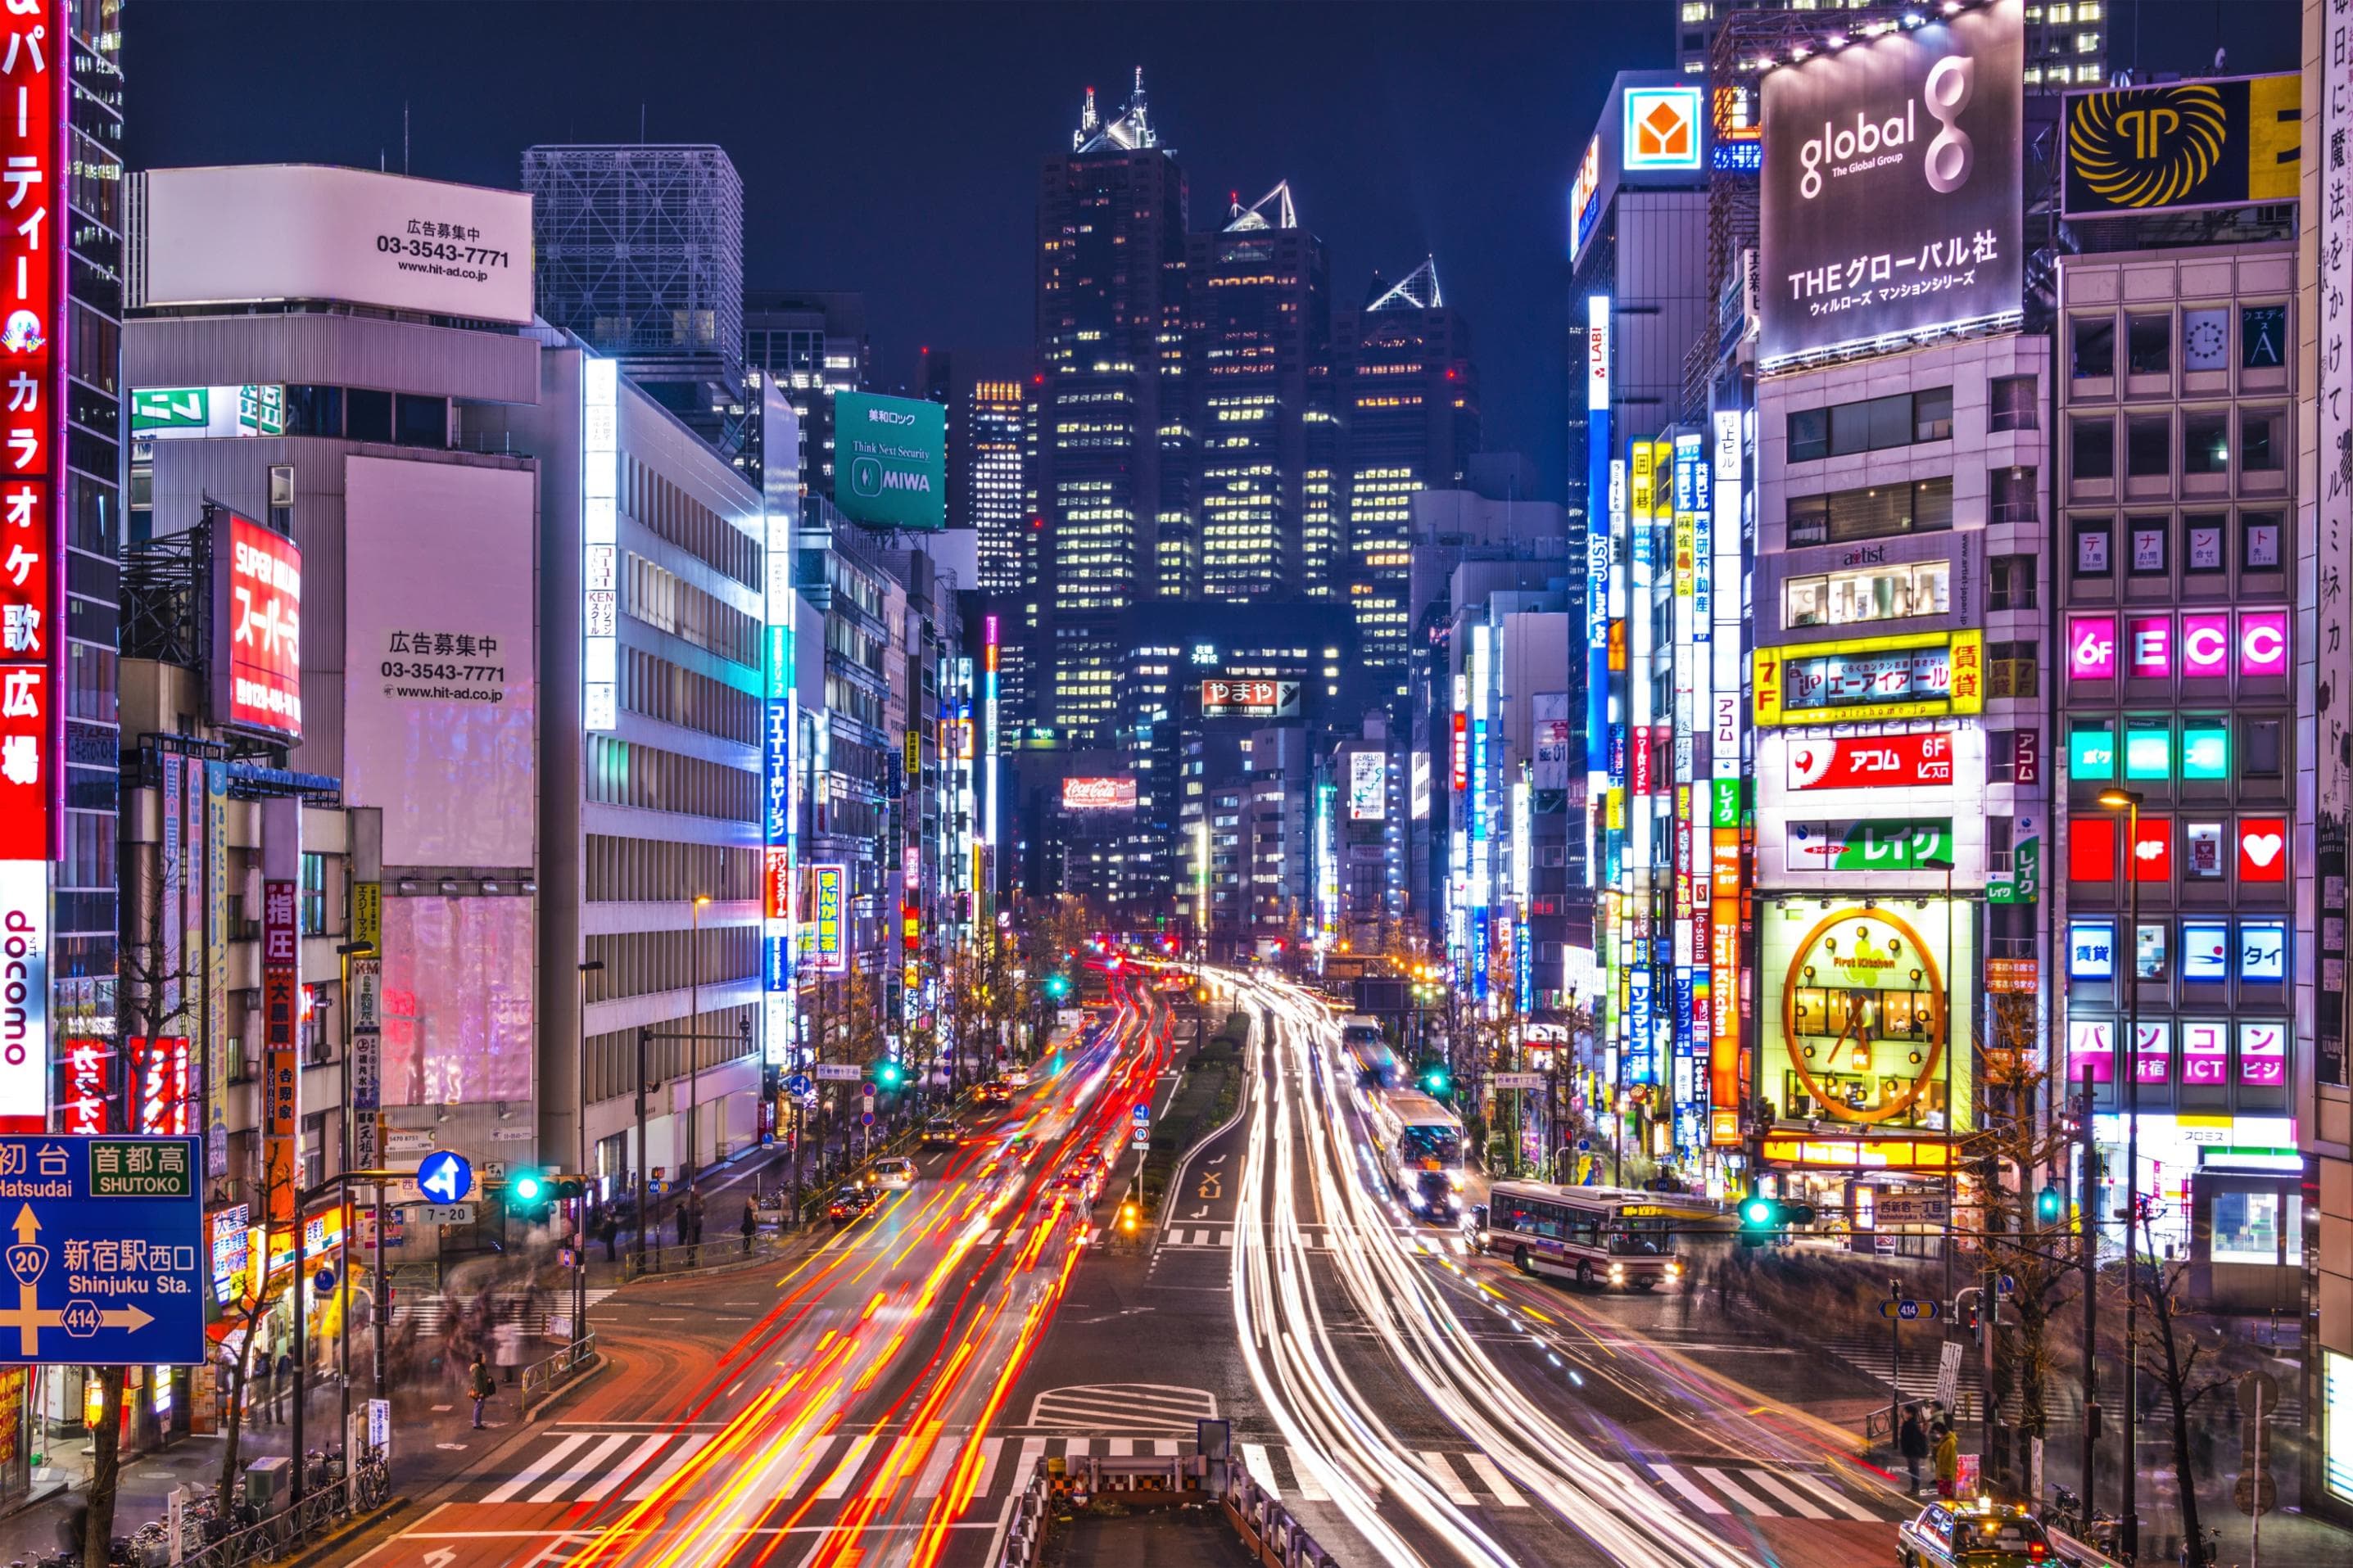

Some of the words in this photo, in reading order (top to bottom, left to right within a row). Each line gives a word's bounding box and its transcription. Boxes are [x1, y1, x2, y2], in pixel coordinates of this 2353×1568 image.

[1800, 98, 1915, 200] global
[1832, 166, 1847, 178] The
[1848, 158, 1876, 174] Global
[1877, 151, 1903, 168] Group
[406, 218, 480, 243] 広告募集中
[377, 236, 509, 269] 03-3543-7771
[1788, 229, 1998, 300] THEグローバル社
[398, 260, 488, 282] www.hit-ad.co.jp
[1809, 290, 1872, 317] ウィルローズ
[1878, 270, 1975, 301] マンションシリーズ
[1591, 328, 1602, 361] LABI
[868, 409, 916, 426] 美和ロック
[853, 441, 876, 454] Think
[878, 443, 897, 456] Next
[898, 446, 930, 460] Security
[883, 470, 931, 492] MIWA
[1591, 534, 1608, 582] JUST
[1695, 518, 1708, 612] 秀研不動産
[1844, 547, 1885, 567] artist
[589, 593, 613, 602] KEN
[1591, 591, 1606, 620] Your
[591, 603, 600, 635] スクール
[604, 603, 612, 635] パソコン
[2328, 471, 2342, 755] ルミネカード
[389, 631, 497, 657] 広告募集中
[1591, 621, 1606, 648] For
[2076, 632, 2112, 666] 6F
[381, 661, 505, 682] 03-3543-7771
[1830, 668, 1949, 695] エーアイアール
[1953, 644, 1979, 698] 賃貸
[1992, 661, 2011, 695] 賃貸
[2016, 662, 2033, 694] 7F
[396, 685, 503, 703] www.hit-ad.co.jp
[1210, 683, 1273, 703] やまや
[1758, 662, 1776, 711] 7F
[1719, 699, 1734, 742] アコム
[1850, 749, 1900, 773] アコム
[1922, 738, 1946, 757] 6F
[2019, 734, 2034, 780] アコム
[1932, 766, 1949, 779] 入口
[1720, 784, 1734, 821] レイク
[1865, 826, 1939, 861] レイク
[2019, 851, 2034, 894] レイク
[1989, 886, 2011, 898] レイク
[268, 894, 293, 958] 指圧
[1715, 924, 1728, 965] First
[2075, 945, 2110, 963] 賃貸
[2244, 946, 2282, 966] タイ
[1833, 956, 1856, 969] First
[1857, 956, 1895, 969] Kitchen
[5, 910, 35, 1065] docomo
[1715, 969, 1728, 1036] Kitchen
[1631, 988, 1649, 1051] ソフマップ
[1677, 981, 1690, 1028] ソフマップ
[2187, 1060, 2224, 1078] ICT
[2243, 1063, 2280, 1078] ビジ
[278, 1068, 292, 1121] 吉野家
[0, 1143, 70, 1176] 初台
[94, 1146, 184, 1173] 首都高
[100, 1177, 180, 1193] SHUTOKO
[16, 1251, 39, 1272] 20
[64, 1239, 194, 1272] 新宿駅西口
[69, 1276, 148, 1297] Shinjuku
[156, 1276, 192, 1294] Sta.
[67, 1309, 96, 1328] 414
[1900, 1305, 1916, 1316] 414
